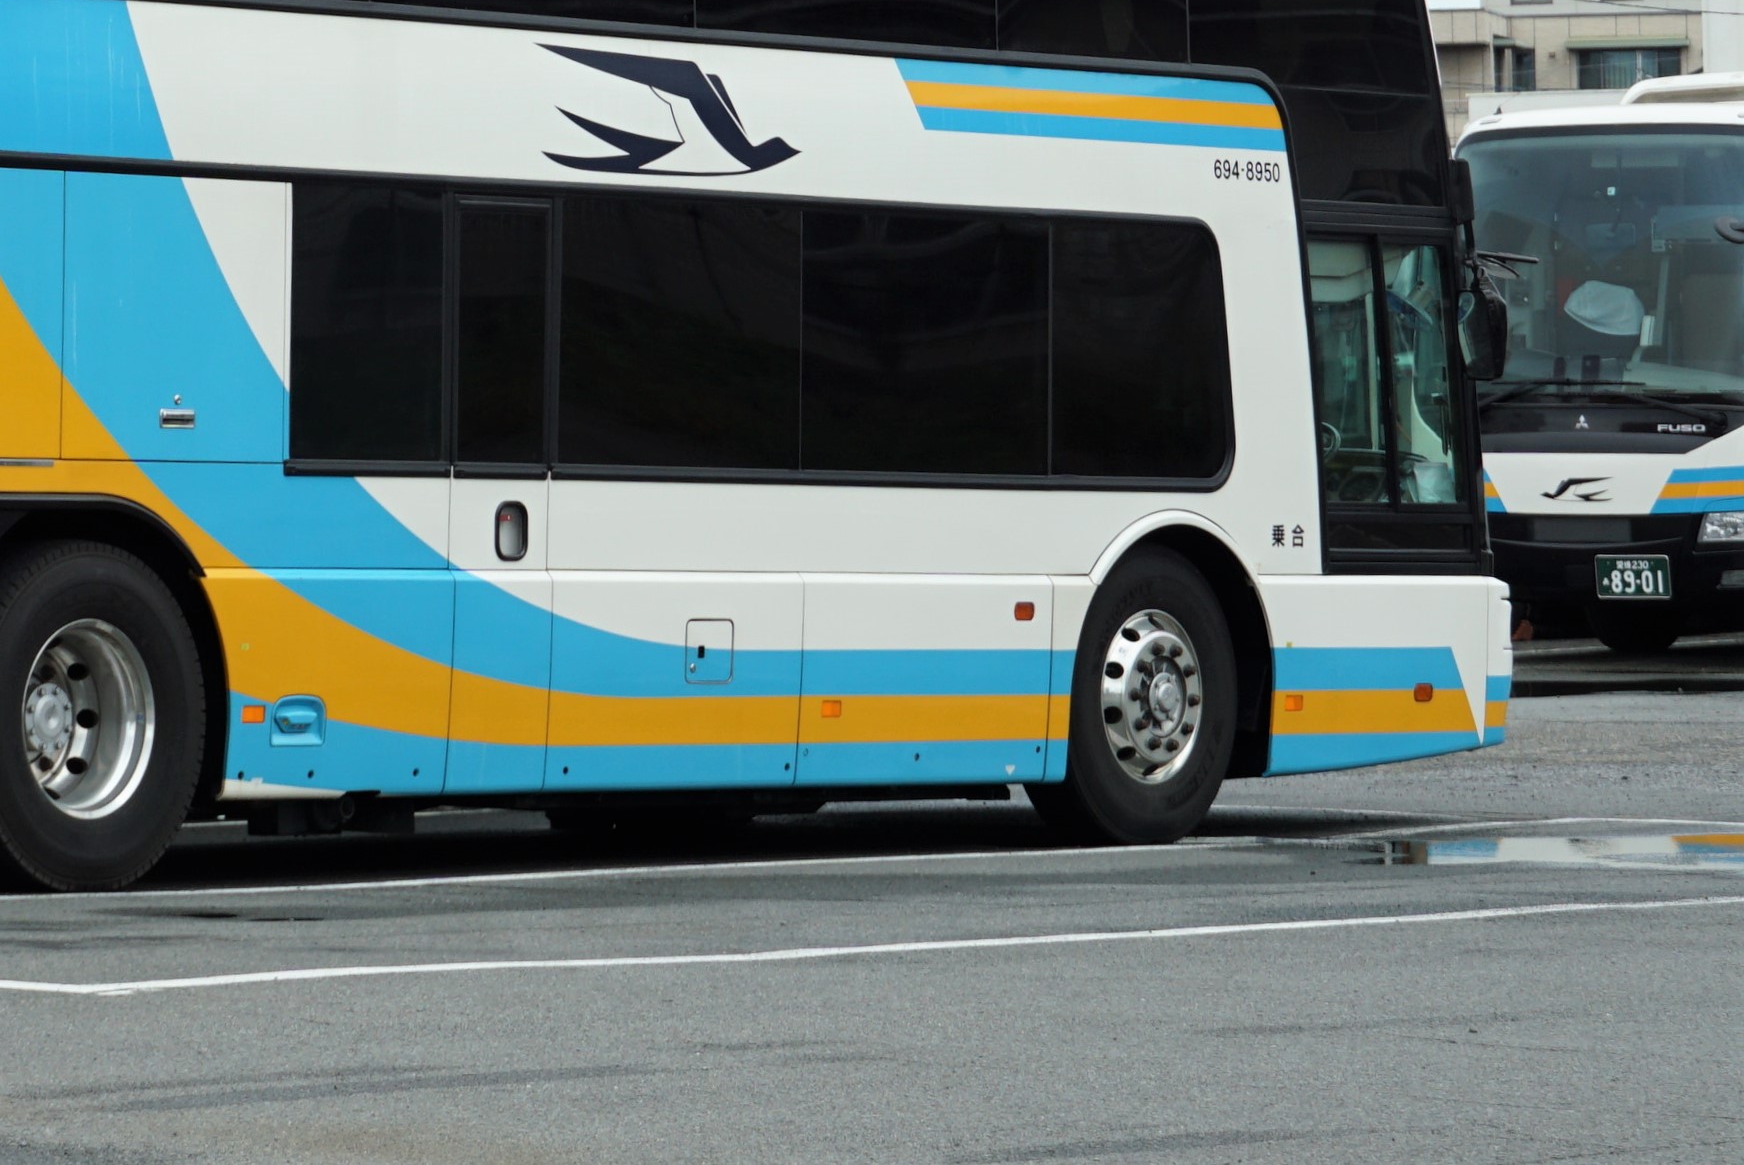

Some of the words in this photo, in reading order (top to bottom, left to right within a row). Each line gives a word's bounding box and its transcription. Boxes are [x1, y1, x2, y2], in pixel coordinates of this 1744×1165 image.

[1657, 423, 1706, 433] FUSO
[1271, 524, 1305, 547] 乗合
[1611, 569, 1663, 594] 89-01
